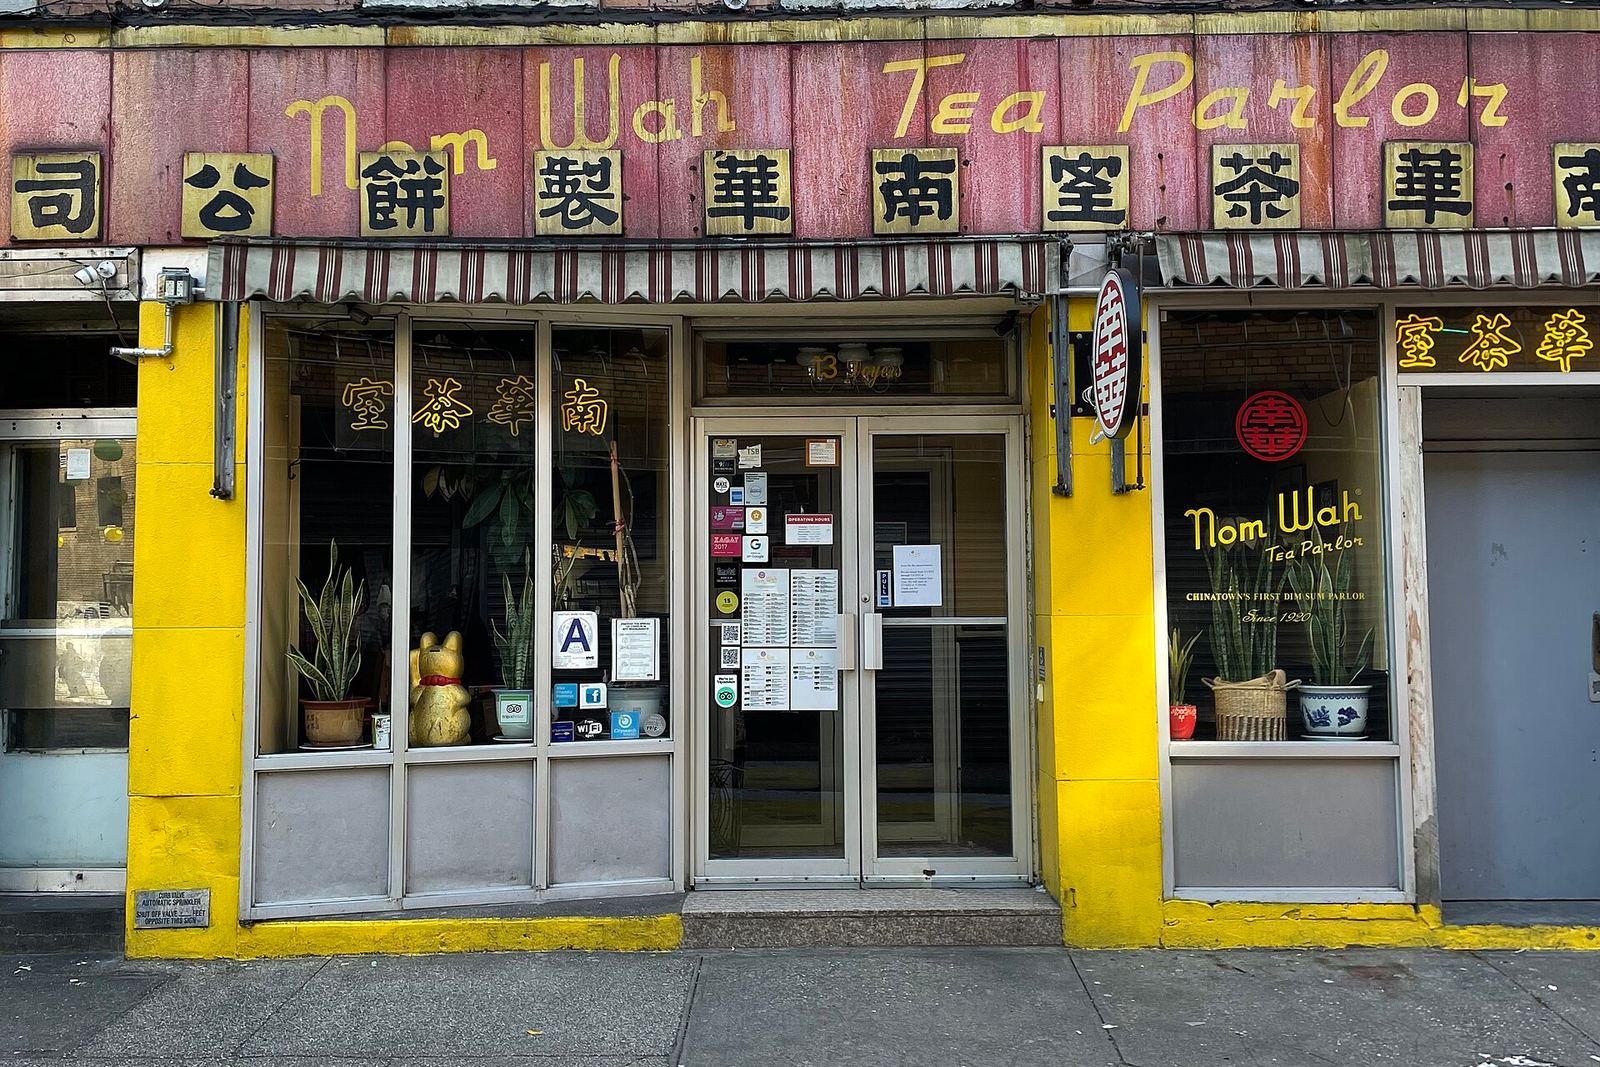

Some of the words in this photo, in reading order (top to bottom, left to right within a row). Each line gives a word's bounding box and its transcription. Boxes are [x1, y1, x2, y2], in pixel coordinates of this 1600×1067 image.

[285, 96, 496, 195] Nm
[540, 52, 736, 150] Wah
[882, 53, 1044, 138] Tea
[1117, 48, 1510, 133] Parlor
[815, 355, 837, 379] 13
[1184, 507, 1267, 550] Nom
[1278, 485, 1362, 533] Wah
[713, 536, 739, 544] ZAGAT
[1265, 545, 1295, 563] Tea
[1300, 535, 1364, 557] Parlor
[1186, 592, 1251, 601] CHINATOWN'S
[1253, 592, 1281, 601] FIRST
[1284, 592, 1302, 601] DIM
[1305, 592, 1323, 601] SUM
[1328, 592, 1366, 601] PARLOR
[1242, 608, 1277, 623] Since
[1279, 611, 1312, 623] 1920
[560, 618, 591, 653] A
[172, 898, 201, 906] SPRINKLER
[144, 917, 170, 925] OPPOSITE
[151, 910, 161, 918] OFF
[192, 909, 206, 917] FEET
